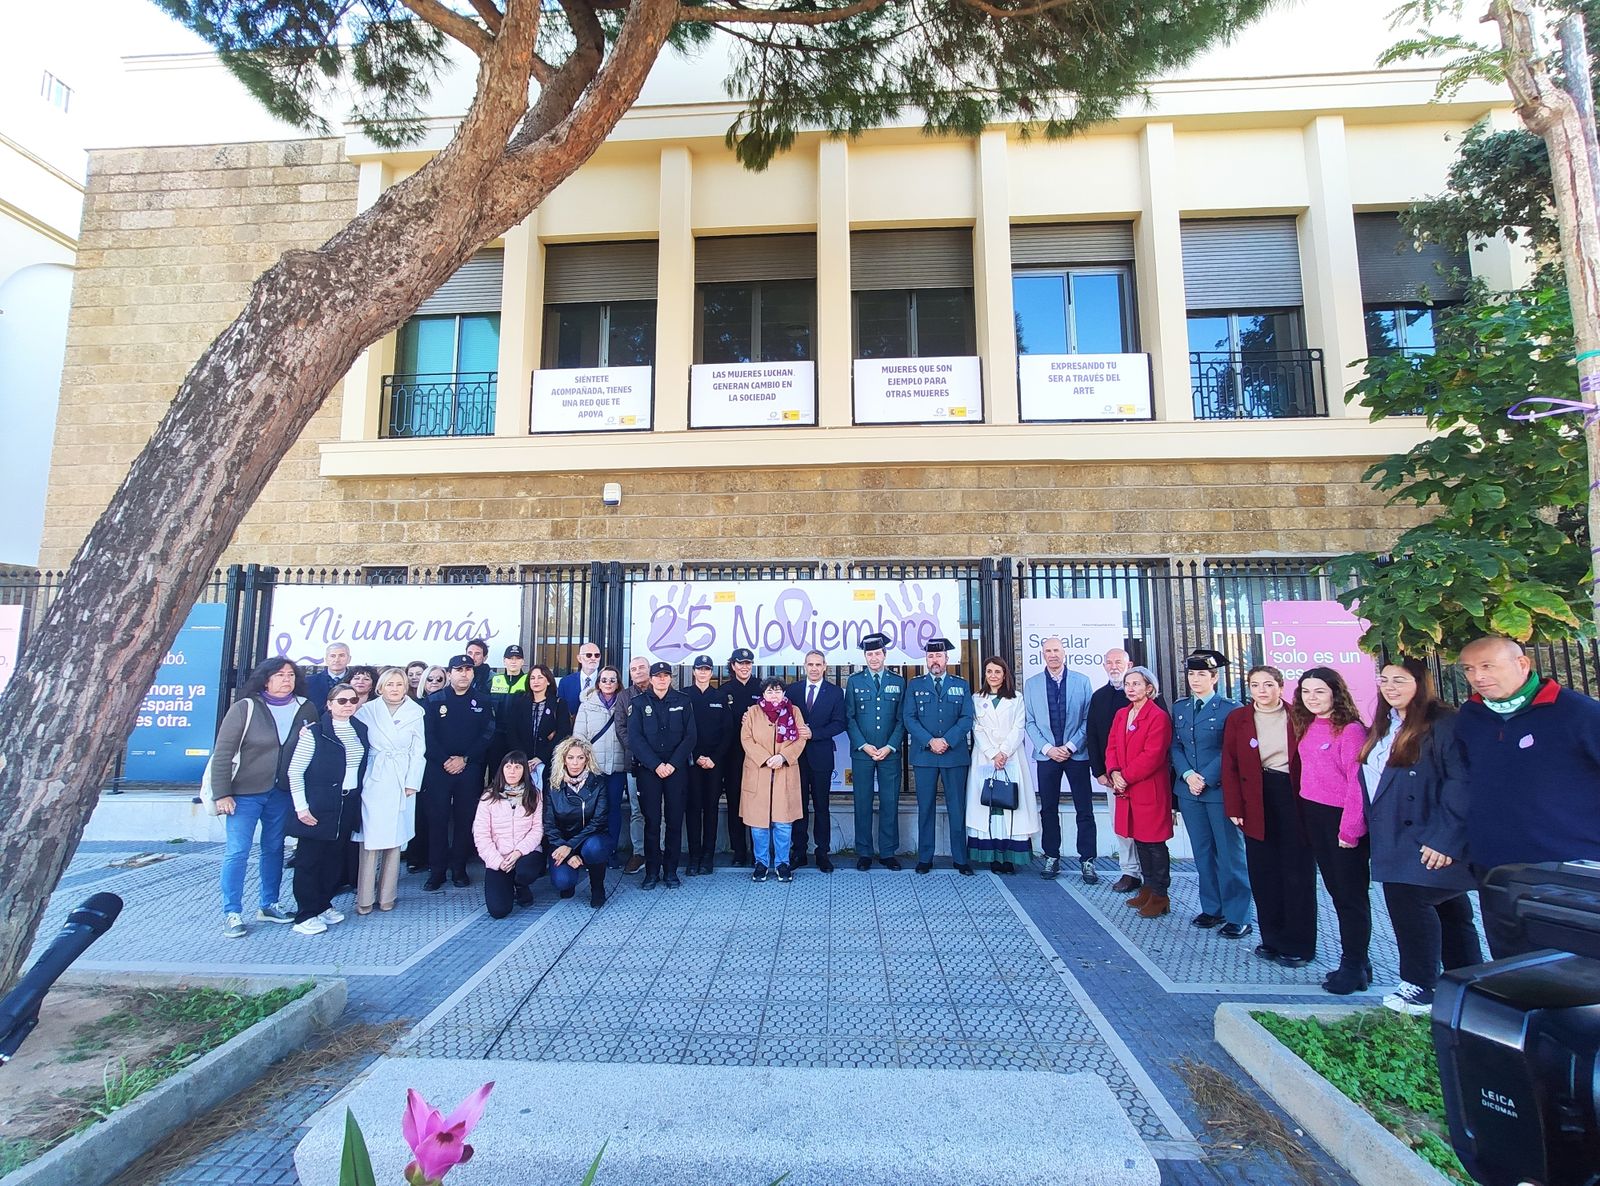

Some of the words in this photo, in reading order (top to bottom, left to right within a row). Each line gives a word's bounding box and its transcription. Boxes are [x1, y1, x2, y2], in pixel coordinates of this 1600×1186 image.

[881, 365, 917, 374] MUJERES
[919, 365, 935, 374] QUE
[936, 364, 953, 372] SON
[1051, 361, 1105, 370] EXPRESANDO
[1106, 361, 1117, 370] TU
[712, 370, 726, 379] LAS
[728, 369, 762, 378] MUJERES
[1048, 374, 1064, 383] SER
[1065, 374, 1071, 382] A
[1072, 372, 1105, 382] TRAVÉS
[1106, 374, 1121, 382] DEL
[712, 382, 750, 390] GENERAN
[751, 381, 781, 389] CAMBIO
[782, 380, 793, 388] EN
[887, 377, 923, 386] EJEMPLO
[924, 377, 947, 385] PARA
[551, 386, 605, 396] ACOMPAÑADA,
[606, 386, 632, 394] TIENES
[885, 390, 912, 398] OTRAS
[913, 389, 950, 397] MUJERES
[1073, 386, 1095, 395] ARTE
[562, 399, 578, 407] UNA
[579, 399, 594, 407] RED
[596, 398, 610, 407] QUE
[611, 398, 621, 406] TE
[728, 394, 738, 402] LA
[740, 393, 777, 402] SOCIEDAD
[578, 410, 604, 418] APOYA
[300, 606, 345, 644] Ni
[351, 619, 419, 642] una
[423, 611, 500, 643] más
[650, 604, 717, 652] 25
[733, 602, 937, 651] Noviembre
[1271, 631, 1296, 647] De
[1029, 650, 1042, 666] al
[1313, 651, 1334, 664] es
[1339, 651, 1361, 664] un
[188, 684, 206, 700] ya
[136, 715, 153, 727] es
[156, 713, 192, 727] otra.
[1481, 1087, 1516, 1109] LEICA
[1481, 1098, 1519, 1120] DICOMAR
